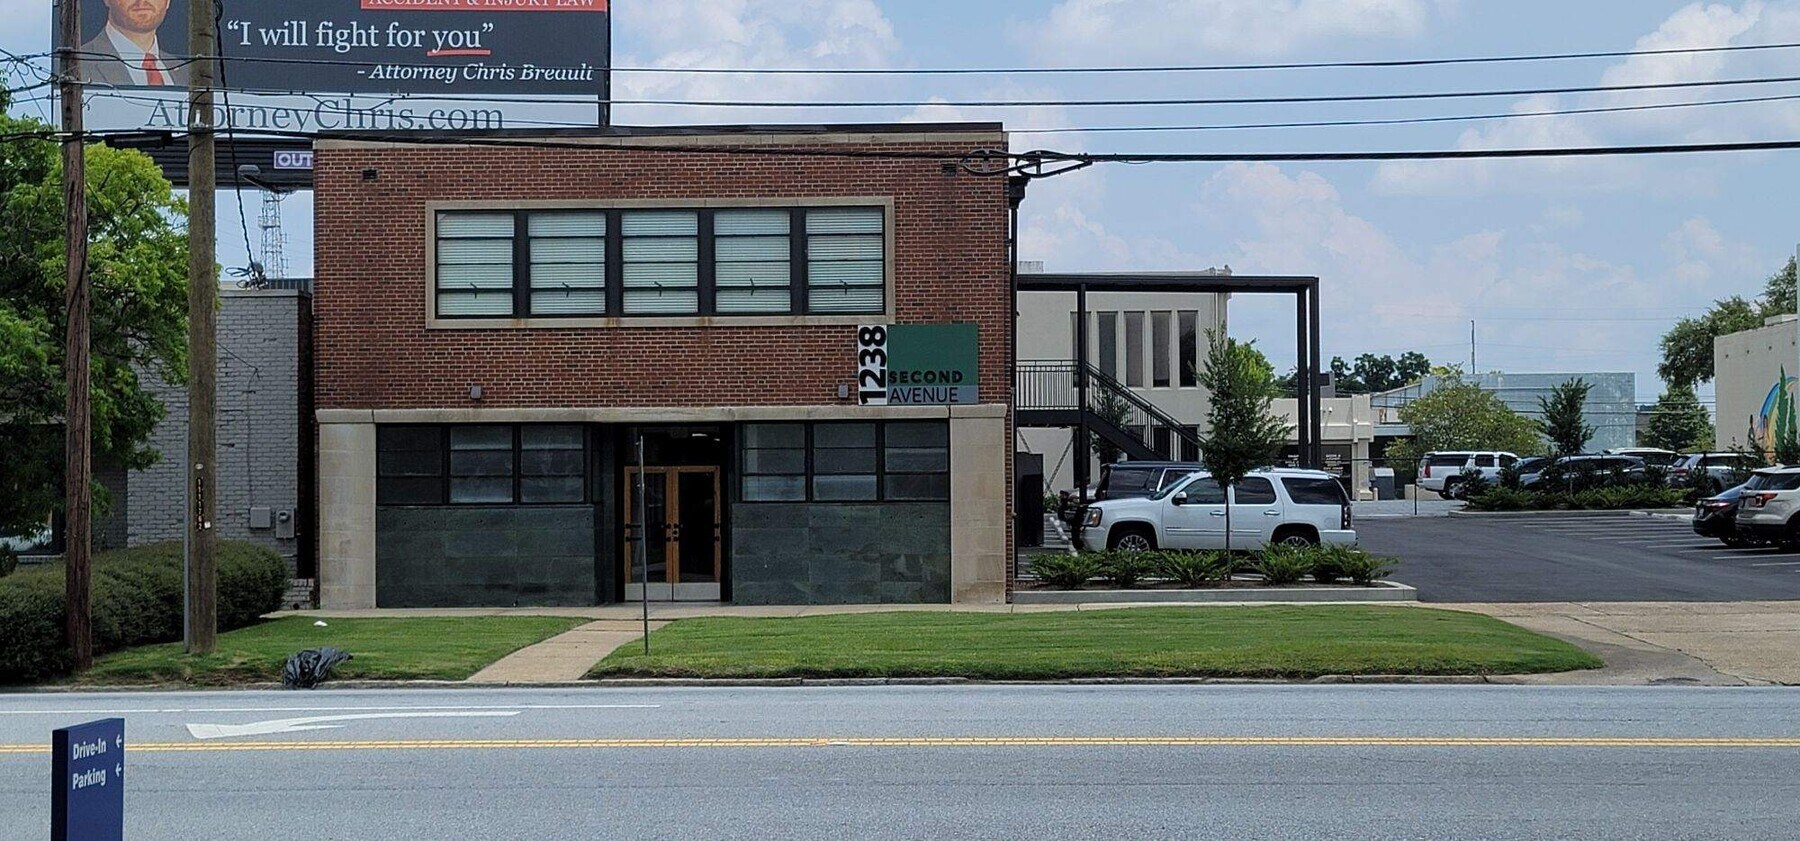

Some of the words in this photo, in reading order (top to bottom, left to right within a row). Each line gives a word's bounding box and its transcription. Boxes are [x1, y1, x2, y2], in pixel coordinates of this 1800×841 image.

[259, 20, 308, 46] will
[316, 21, 379, 53] fight
[386, 22, 426, 47] for
[432, 23, 493, 52] you”
[368, 64, 457, 83] Attorney
[463, 63, 515, 80] Chris
[144, 98, 503, 131] AtorneyChris.com
[278, 153, 313, 167] OUT
[859, 326, 886, 405] 1238
[889, 370, 963, 384] SECOND
[889, 387, 959, 403] AVENUE
[73, 738, 107, 760] Drive-In
[72, 768, 106, 790] Parking
